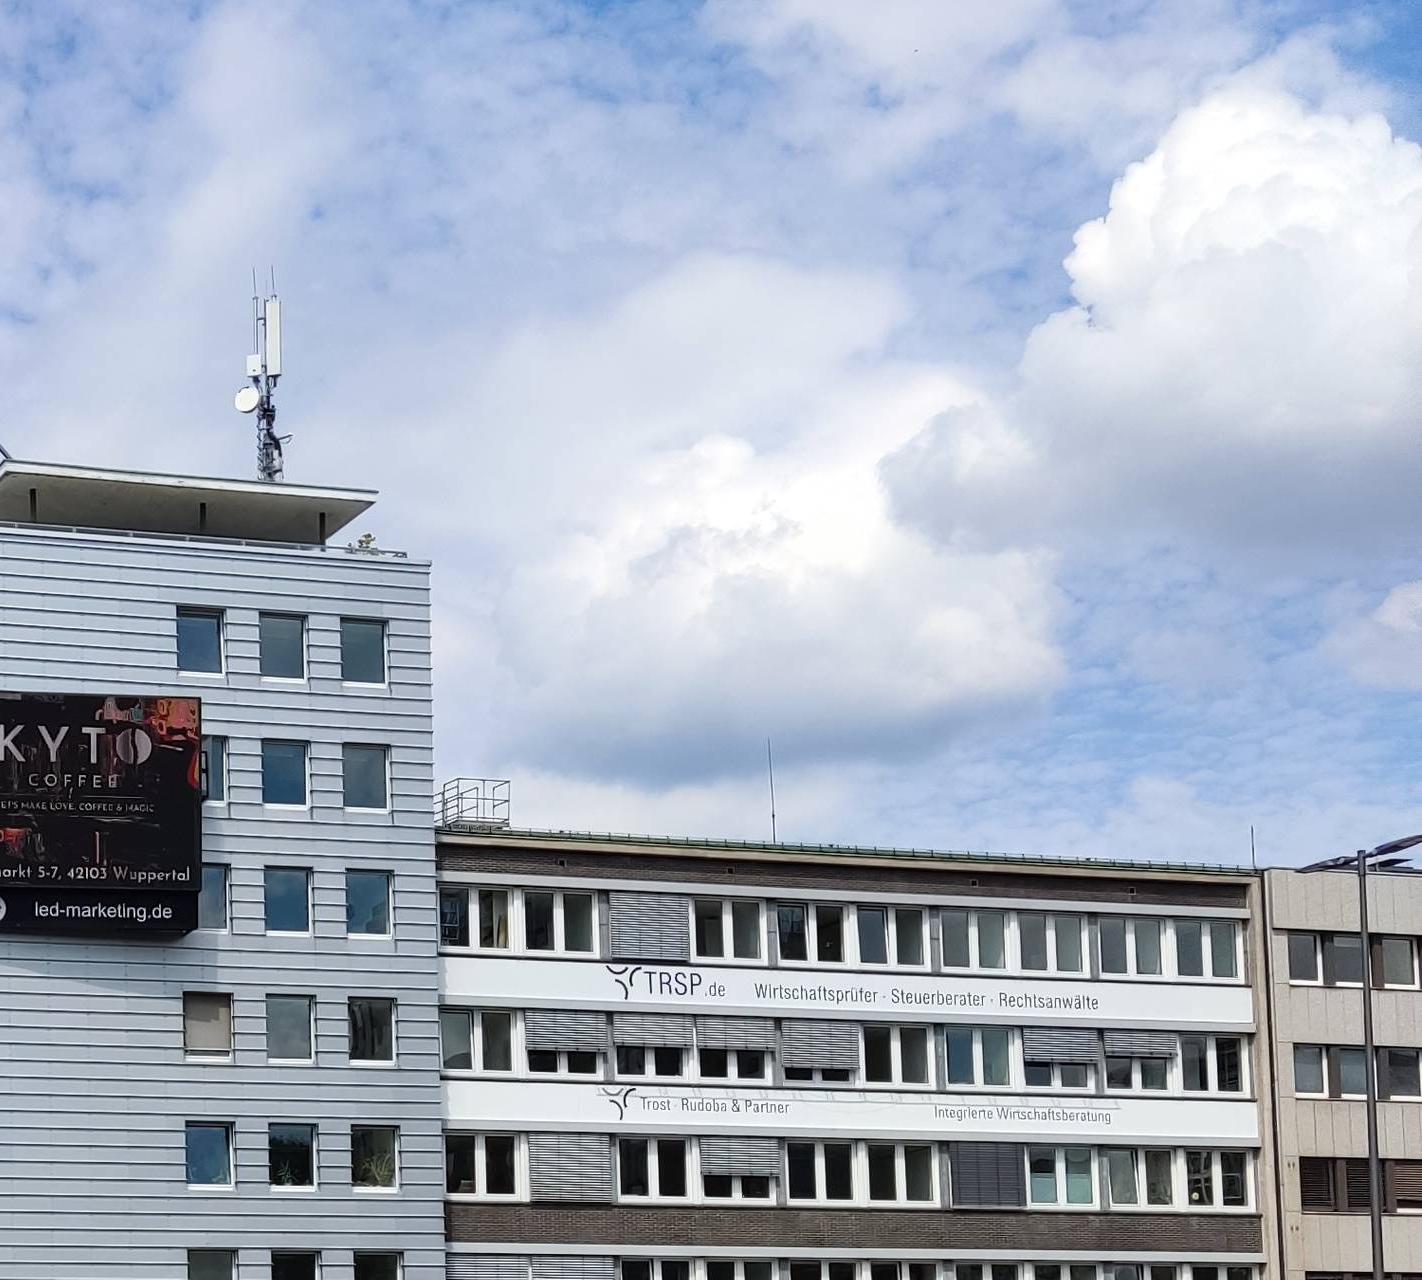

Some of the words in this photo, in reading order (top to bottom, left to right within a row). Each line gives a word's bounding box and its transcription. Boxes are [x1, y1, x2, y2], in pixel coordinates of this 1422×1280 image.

[28, 774, 117, 788] COFFEE
[21, 801, 46, 810] MAKE
[79, 802, 113, 812] COFFEE
[116, 804, 123, 812] &
[125, 803, 155, 813] MAGIC
[38, 866, 62, 881] 5-7,
[67, 866, 107, 880] 42103
[113, 866, 190, 884] Wuppertal
[34, 902, 173, 921] led-marketing.de
[755, 983, 878, 1005] Wirtschaftsprüfer
[891, 988, 987, 1007] Steuerberater
[999, 992, 1099, 1010] Rechtsanwälte
[641, 1096, 671, 1111] Trost
[681, 1097, 727, 1112] Rudoba
[731, 1099, 741, 1113] &
[745, 1099, 790, 1114] Partner
[934, 1105, 993, 1121] Integrierte
[996, 1107, 1112, 1125] Wirtschaftsberatung
